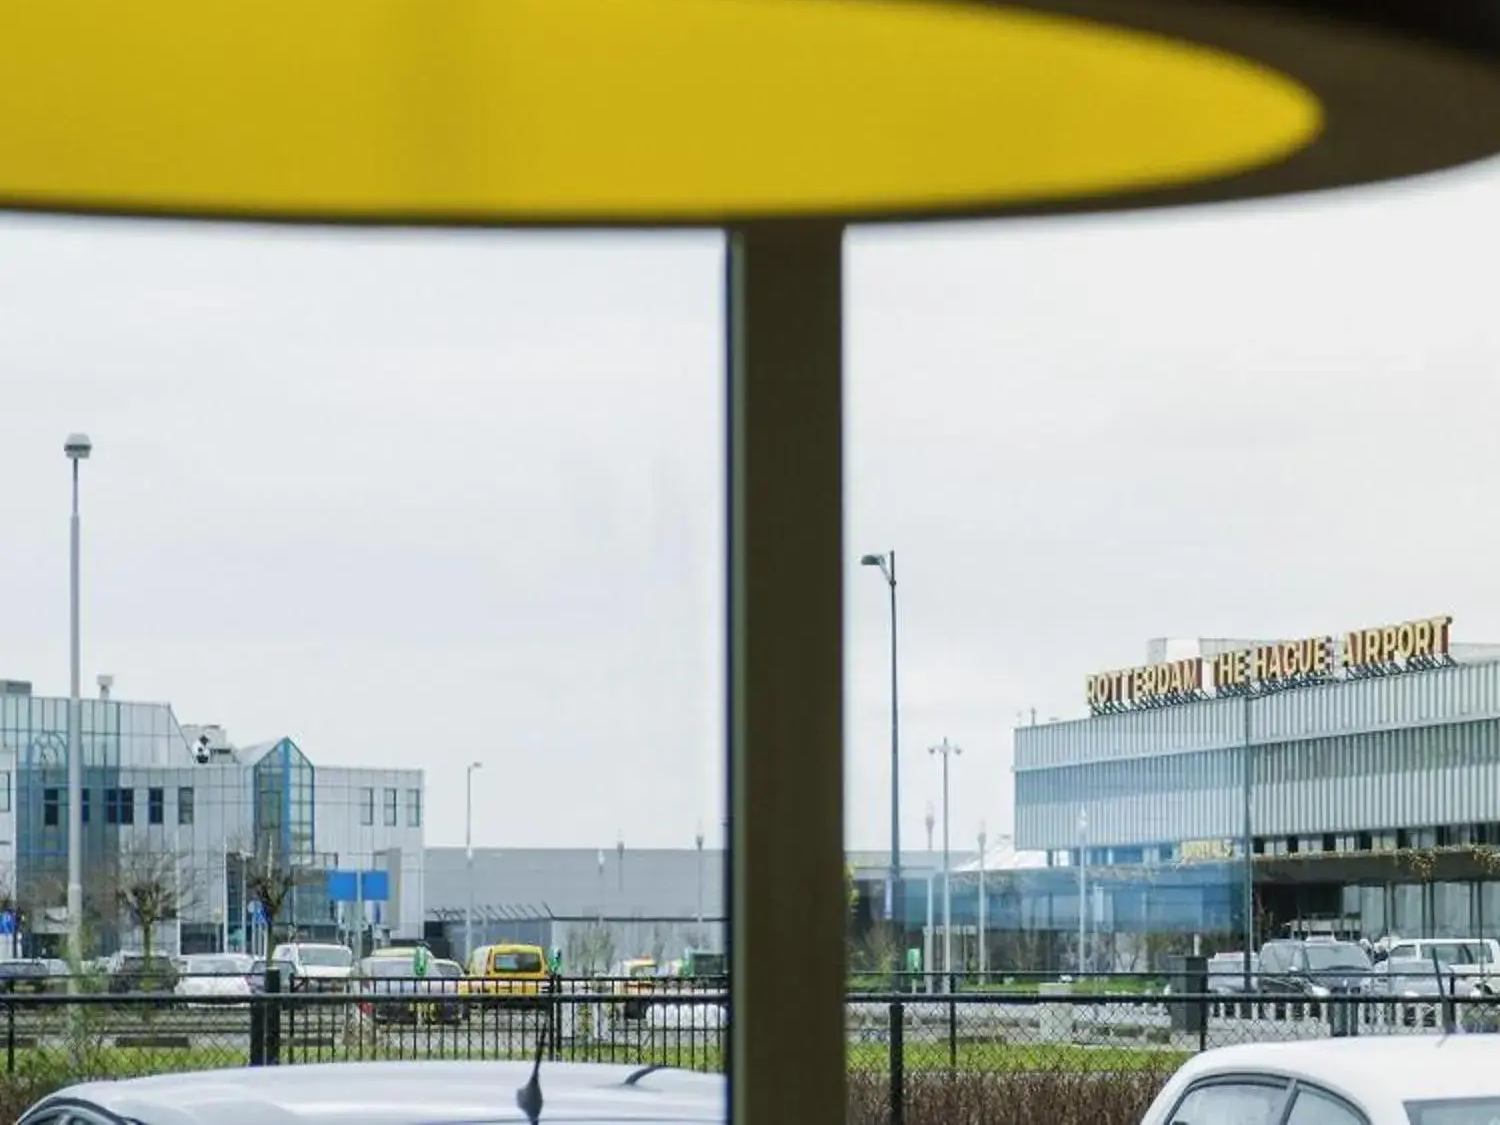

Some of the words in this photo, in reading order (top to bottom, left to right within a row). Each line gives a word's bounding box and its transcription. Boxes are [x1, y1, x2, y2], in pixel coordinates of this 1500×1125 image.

[1085, 658, 1203, 704] ROTTERDAM
[1209, 648, 1252, 687] THE
[1255, 636, 1332, 681] HAGUE
[1343, 616, 1452, 667] AIRPORT
